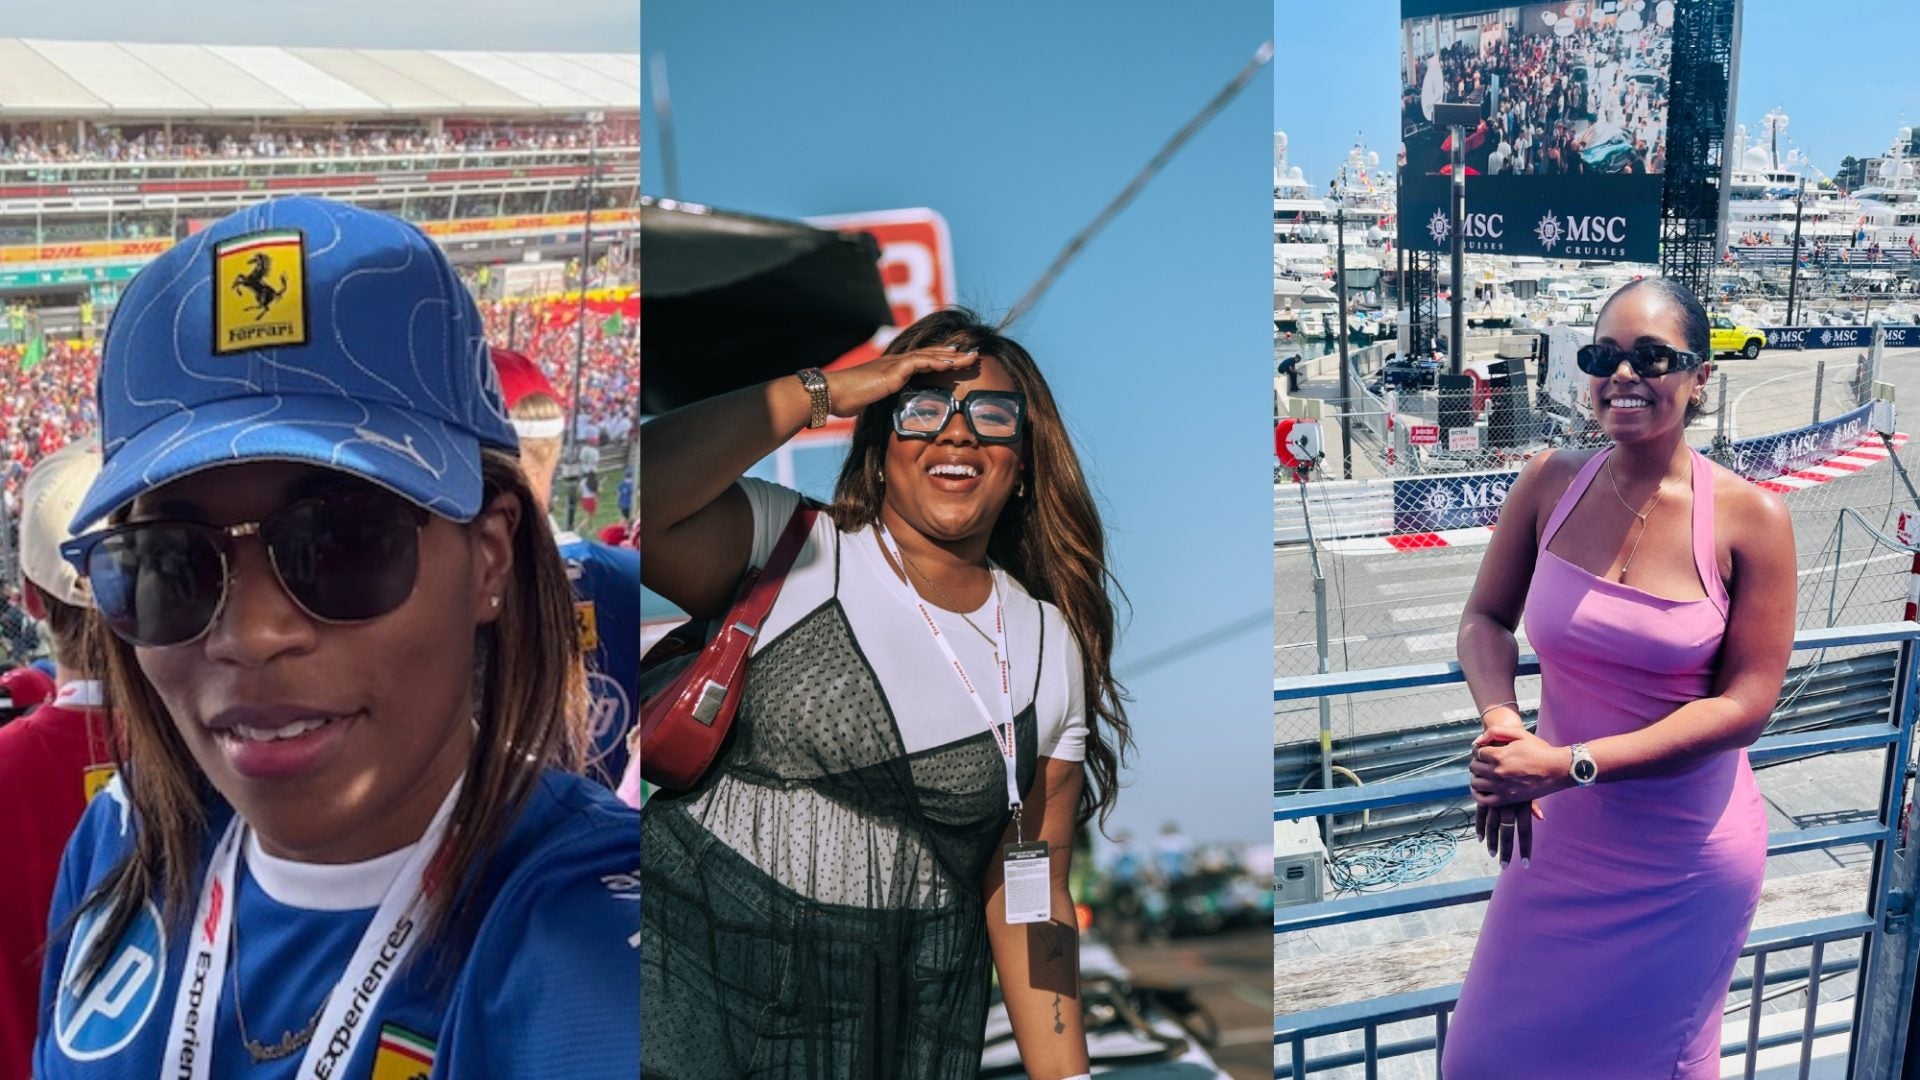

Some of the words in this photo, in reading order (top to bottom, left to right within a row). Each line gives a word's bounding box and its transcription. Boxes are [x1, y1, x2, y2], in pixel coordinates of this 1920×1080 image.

[1566, 215, 1627, 243] MSC
[1463, 242, 1504, 250] UISES
[1565, 246, 1626, 256] CRUISES
[40, 247, 83, 260] DHL
[228, 323, 294, 342] Ferrari
[1780, 330, 1805, 342] MSC
[1833, 329, 1858, 341] MSC
[1789, 433, 1820, 460] MSC
[313, 917, 414, 1080] Experiences
